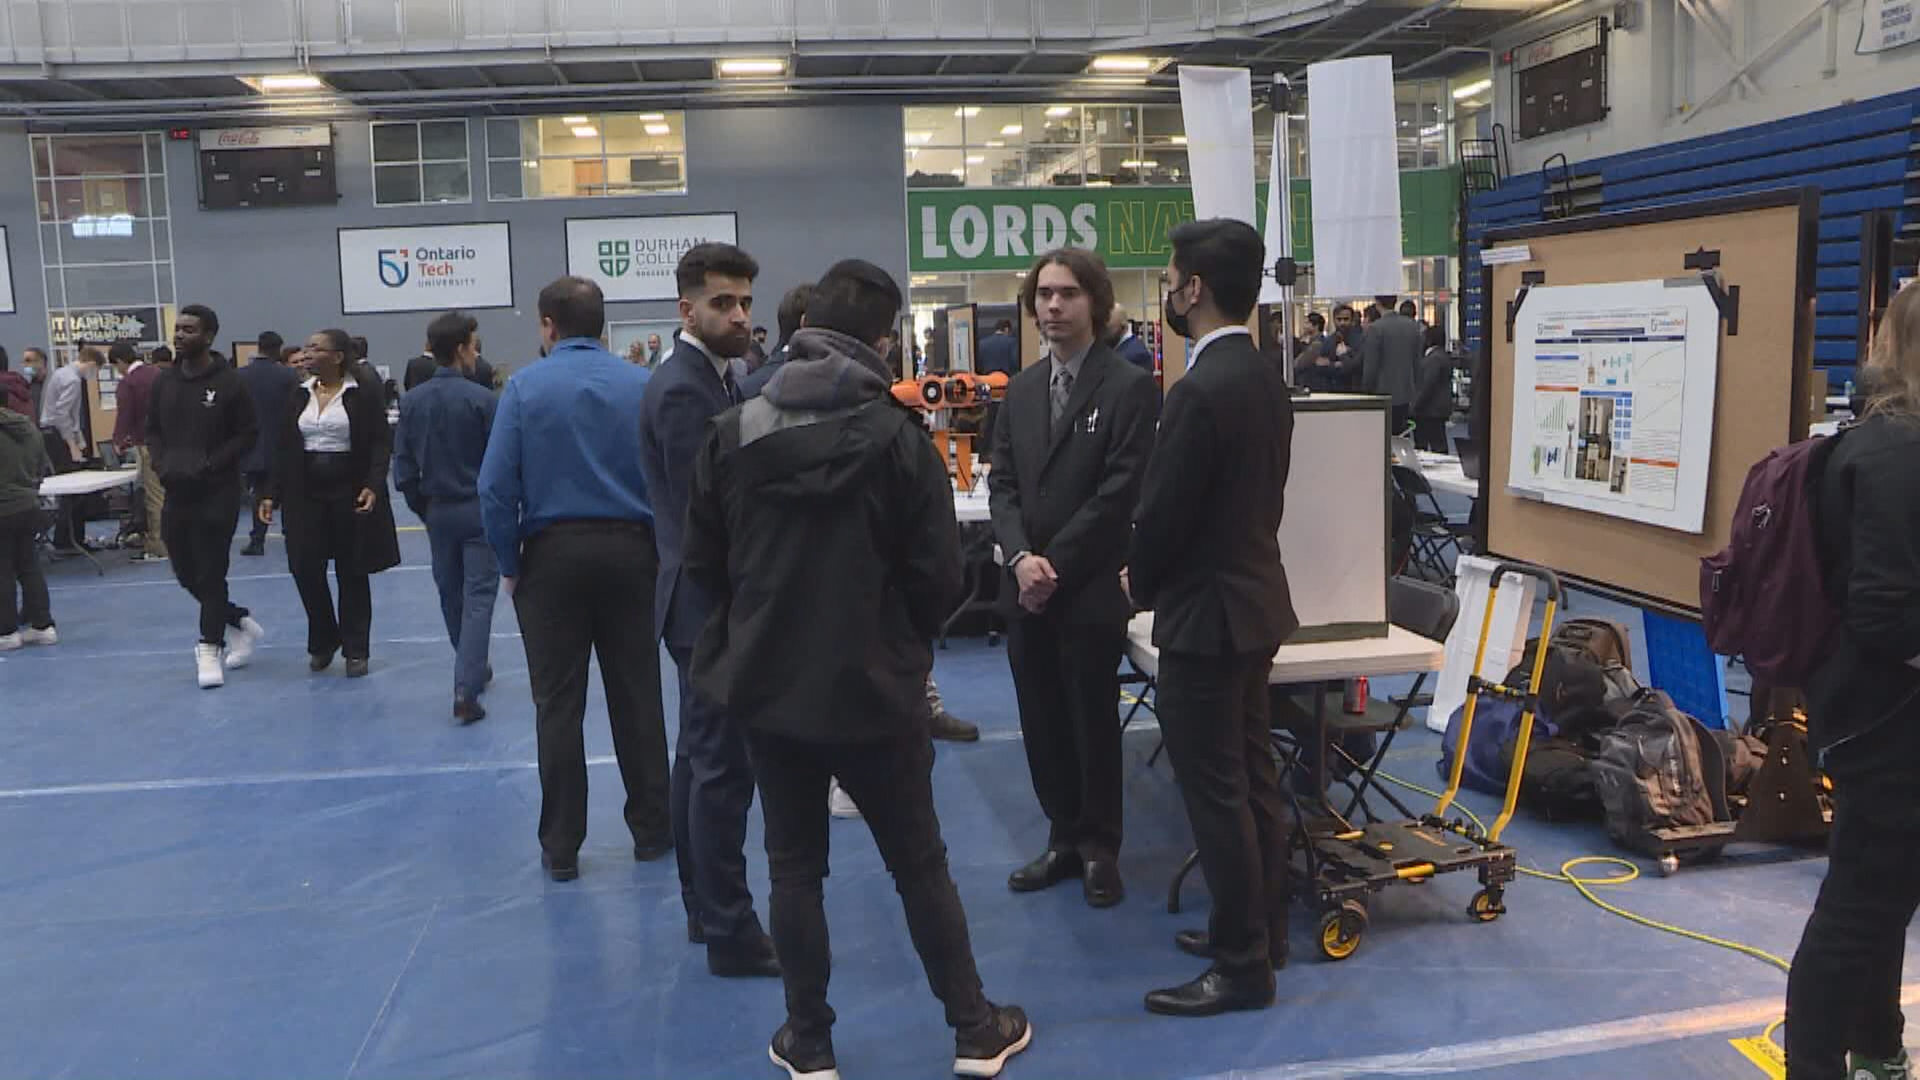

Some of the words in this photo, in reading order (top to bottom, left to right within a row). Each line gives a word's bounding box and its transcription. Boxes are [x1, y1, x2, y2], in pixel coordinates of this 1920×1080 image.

[921, 203, 1098, 258] LORDS
[415, 245, 477, 261] Ontario
[635, 251, 687, 265] COLLE
[418, 262, 454, 277] Tech
[417, 278, 476, 288] UNIVERSITY
